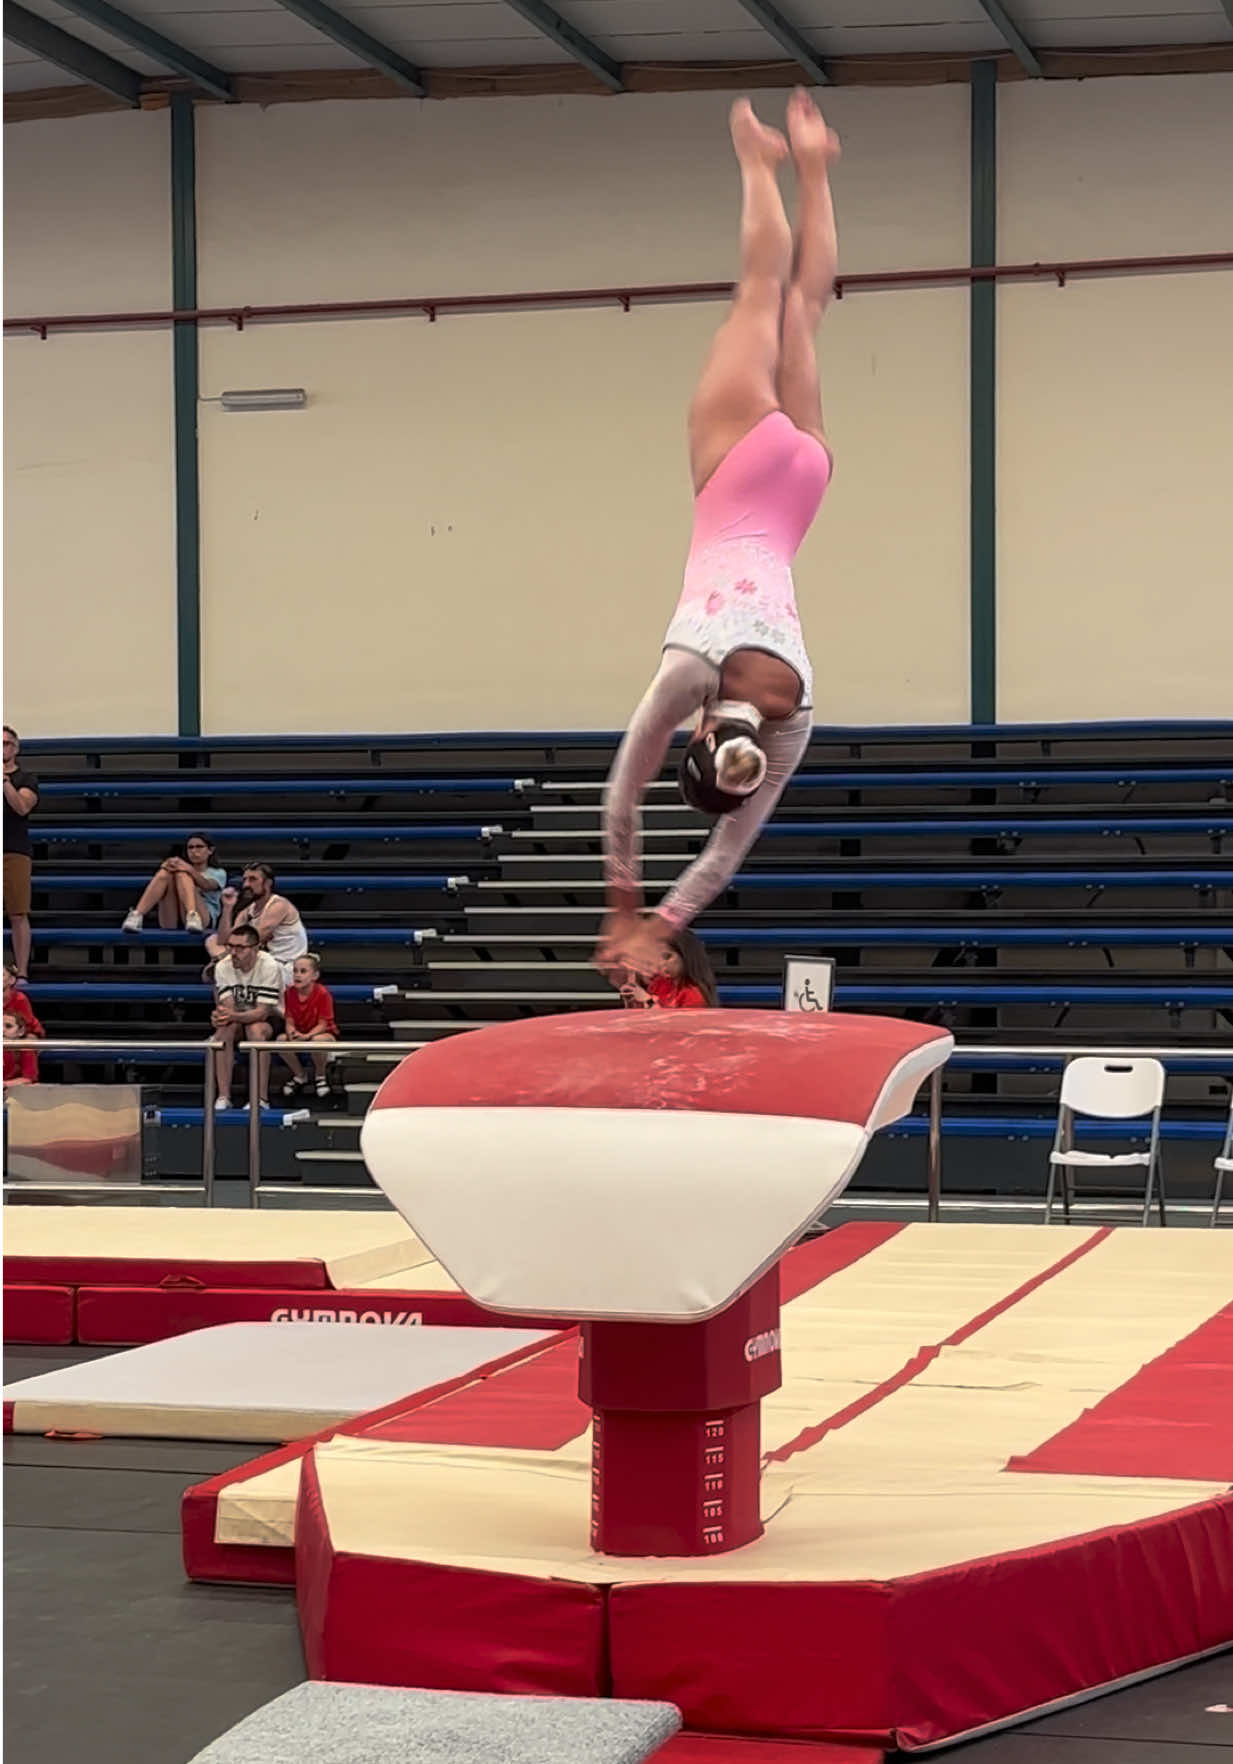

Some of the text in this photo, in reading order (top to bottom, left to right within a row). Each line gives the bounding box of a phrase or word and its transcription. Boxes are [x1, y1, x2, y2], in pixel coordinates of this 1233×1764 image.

[705, 1427, 724, 1438] 120
[705, 1453, 724, 1465] 115
[704, 1480, 723, 1492] 110
[703, 1506, 722, 1518] 105
[703, 1532, 724, 1545] 100
